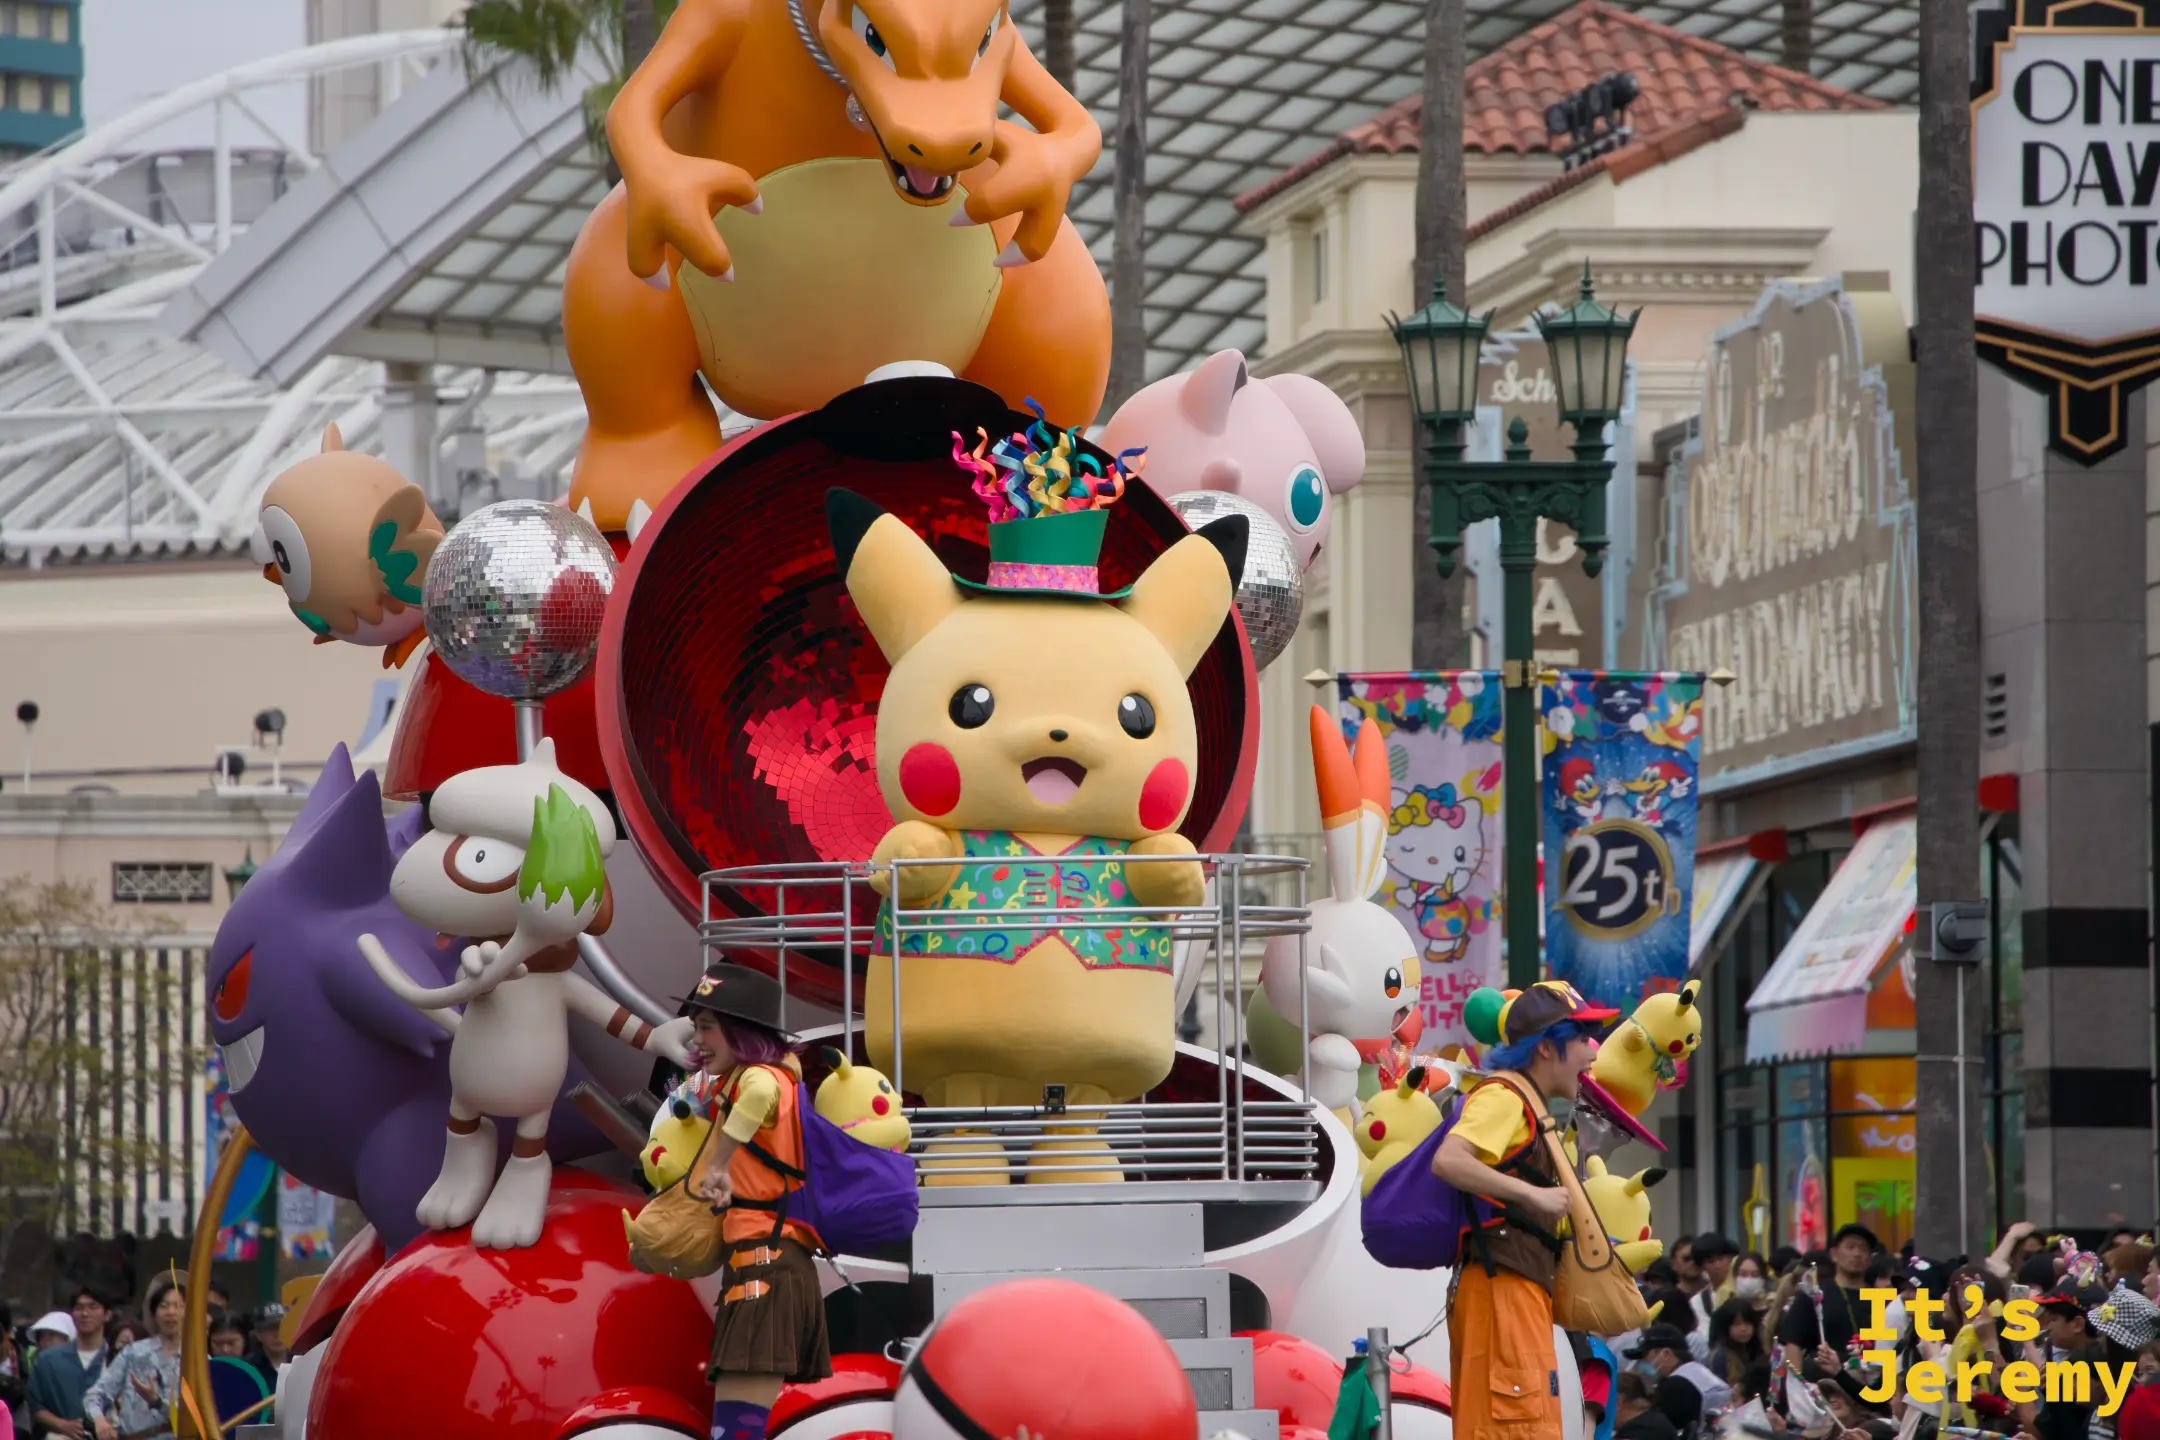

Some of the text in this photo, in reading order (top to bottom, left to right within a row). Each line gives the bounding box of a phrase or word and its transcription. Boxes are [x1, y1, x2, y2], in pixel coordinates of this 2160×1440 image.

[2013, 59, 2160, 125] ONE
[2022, 141, 2160, 207] DAY
[1974, 220, 2160, 287] PHOT
[1489, 359, 1557, 403] Sch
[1421, 973, 1479, 1001] ELLO
[1419, 1002, 1464, 1030] ITT
